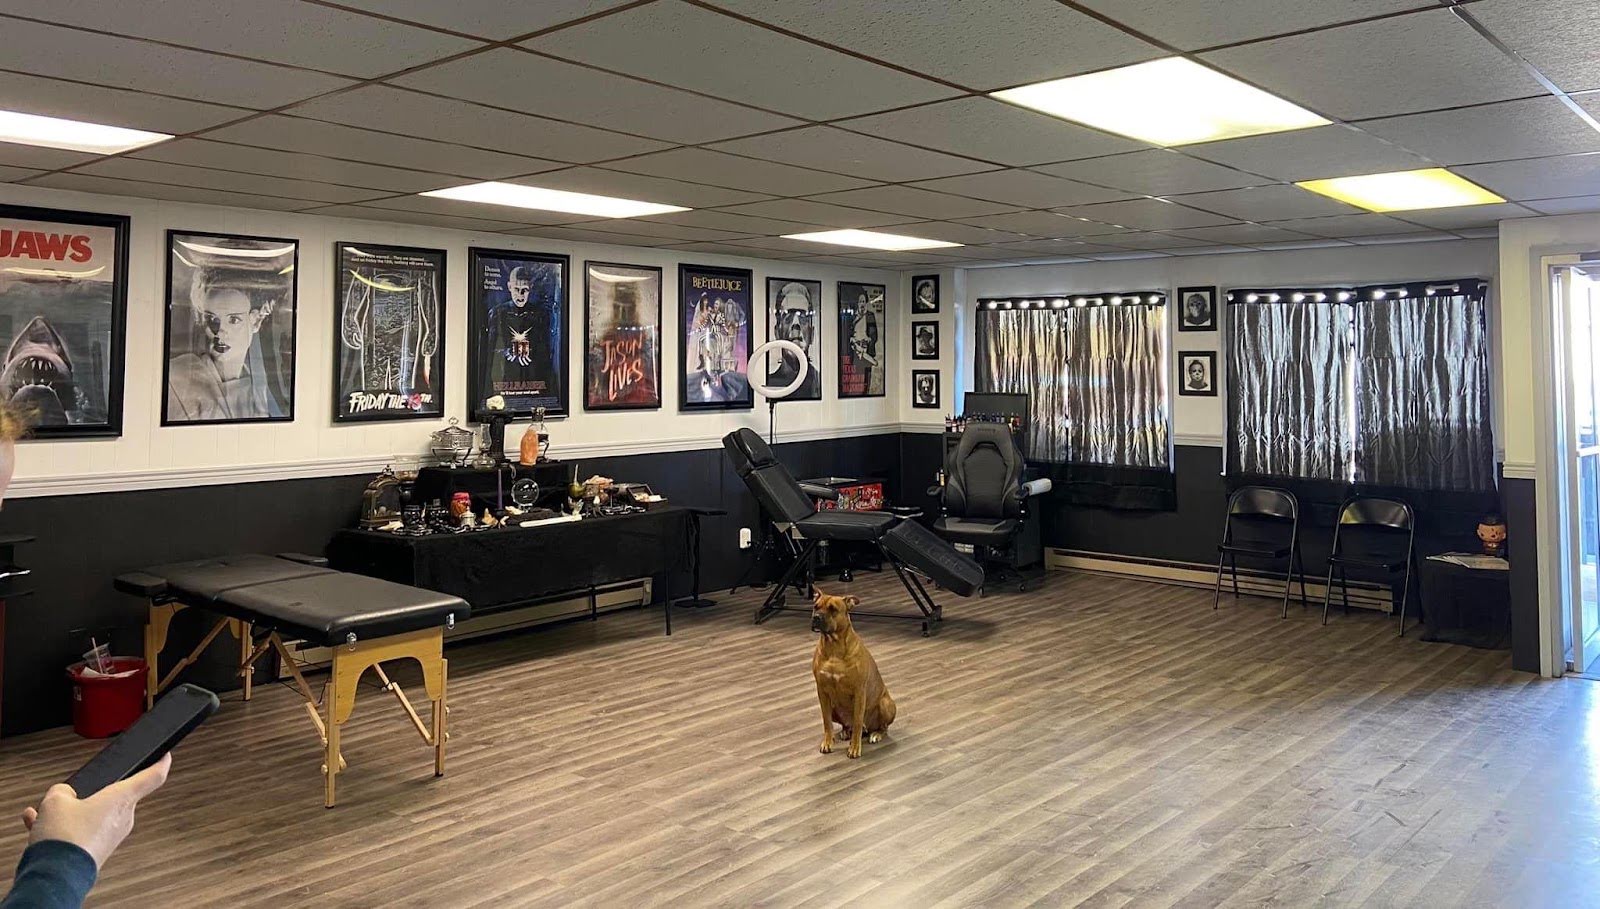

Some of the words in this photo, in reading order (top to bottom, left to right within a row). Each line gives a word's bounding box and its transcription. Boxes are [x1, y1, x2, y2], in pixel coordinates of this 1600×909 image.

[0, 229, 93, 263] JAWS
[692, 276, 742, 291] BEETLEJUICE
[599, 331, 643, 374] JASON
[608, 357, 644, 402] LIVES
[349, 391, 389, 414] FRIDAY
[387, 393, 409, 410] THE
